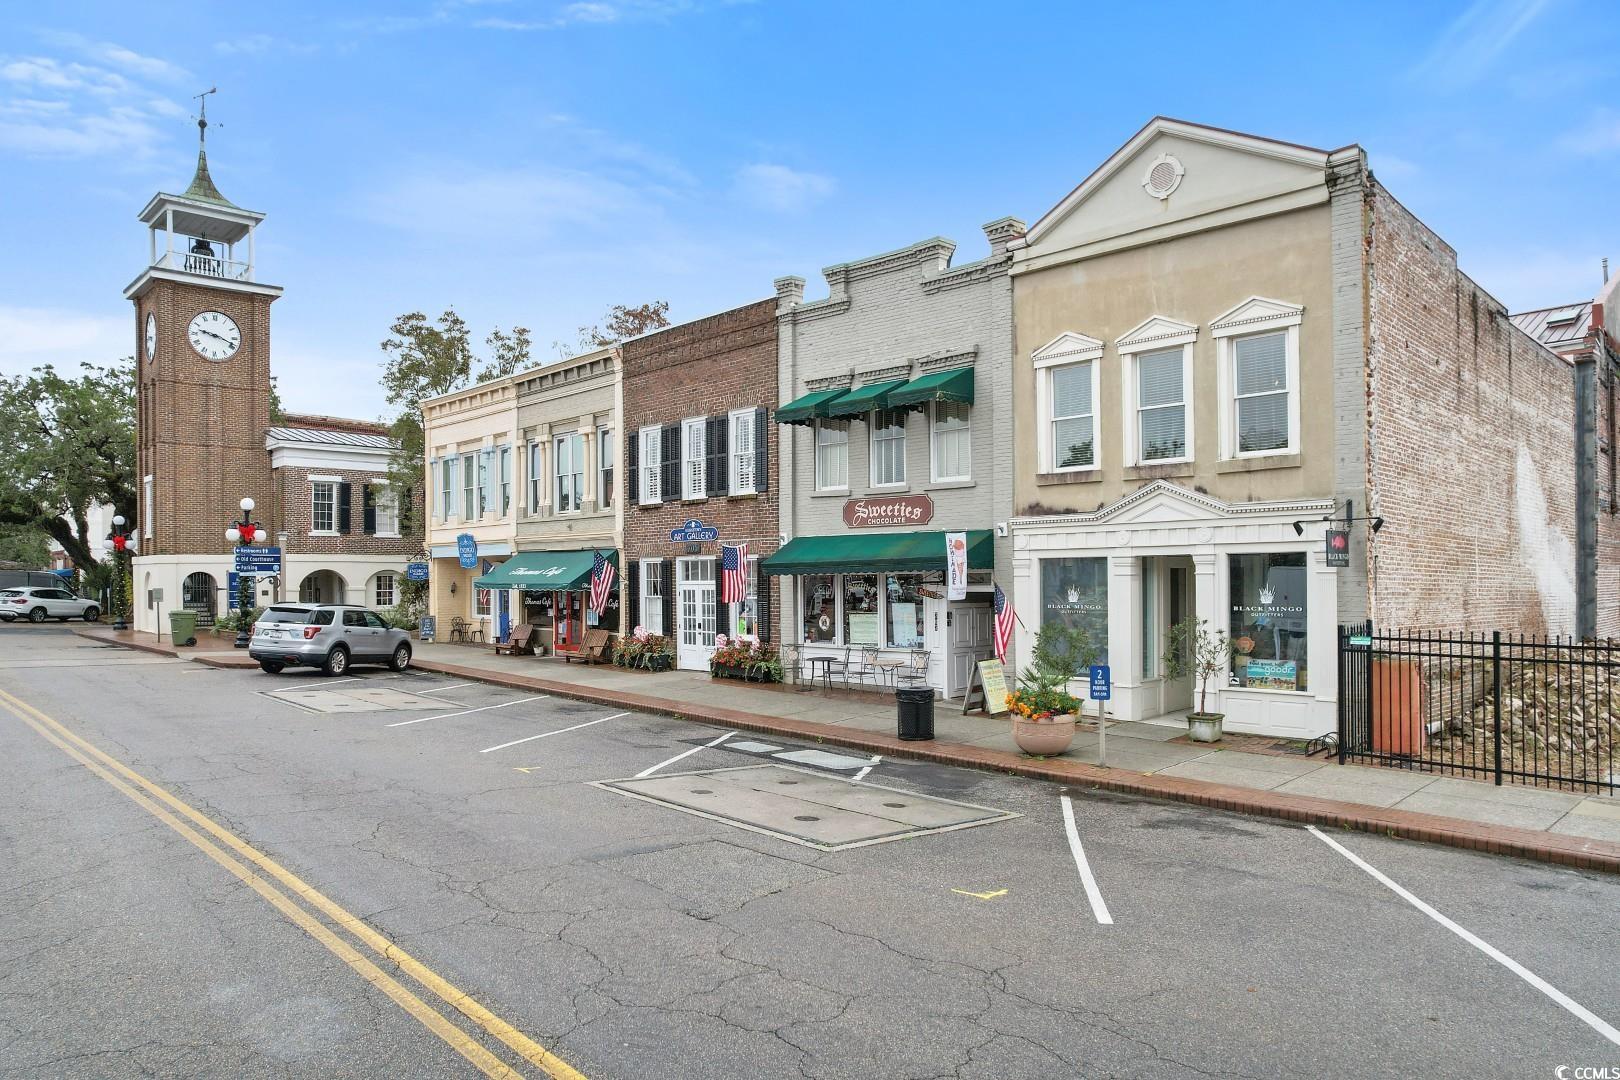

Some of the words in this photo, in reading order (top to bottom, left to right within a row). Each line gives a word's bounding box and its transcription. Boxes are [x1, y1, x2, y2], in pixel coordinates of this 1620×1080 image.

[853, 500, 923, 526] Sweeties
[867, 517, 906, 525] CHOCOLATE
[674, 533, 686, 541] ART
[686, 531, 714, 540] GALLERY
[1097, 669, 1103, 679] 2
